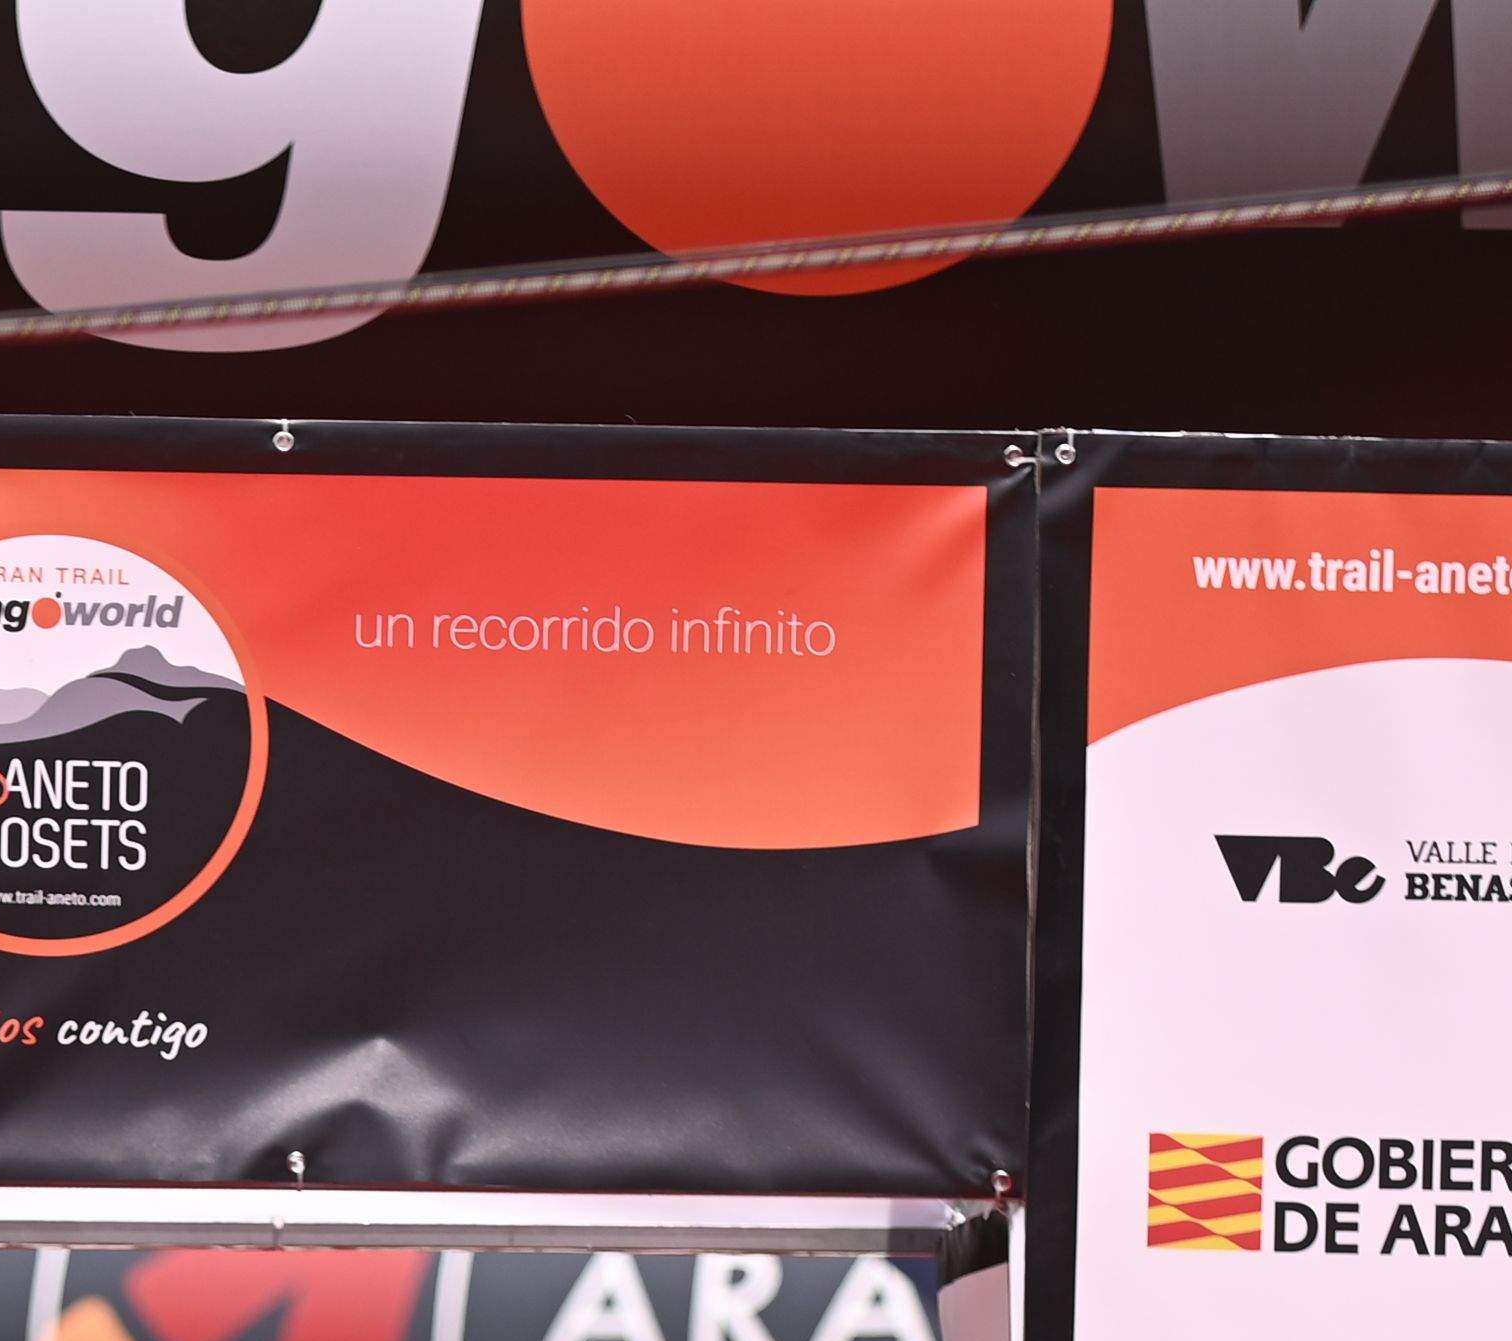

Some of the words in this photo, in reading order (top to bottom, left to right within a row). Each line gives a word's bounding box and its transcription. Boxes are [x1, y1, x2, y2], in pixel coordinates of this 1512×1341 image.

[56, 567, 130, 586] TRAIL
[354, 613, 415, 649] un
[433, 605, 654, 654] recorrido
[670, 606, 836, 657] infinito
[6, 757, 148, 812] ANETO
[1406, 839, 1497, 866] VALLE
[56, 1009, 208, 1061] contigo
[1273, 1201, 1360, 1254] DE
